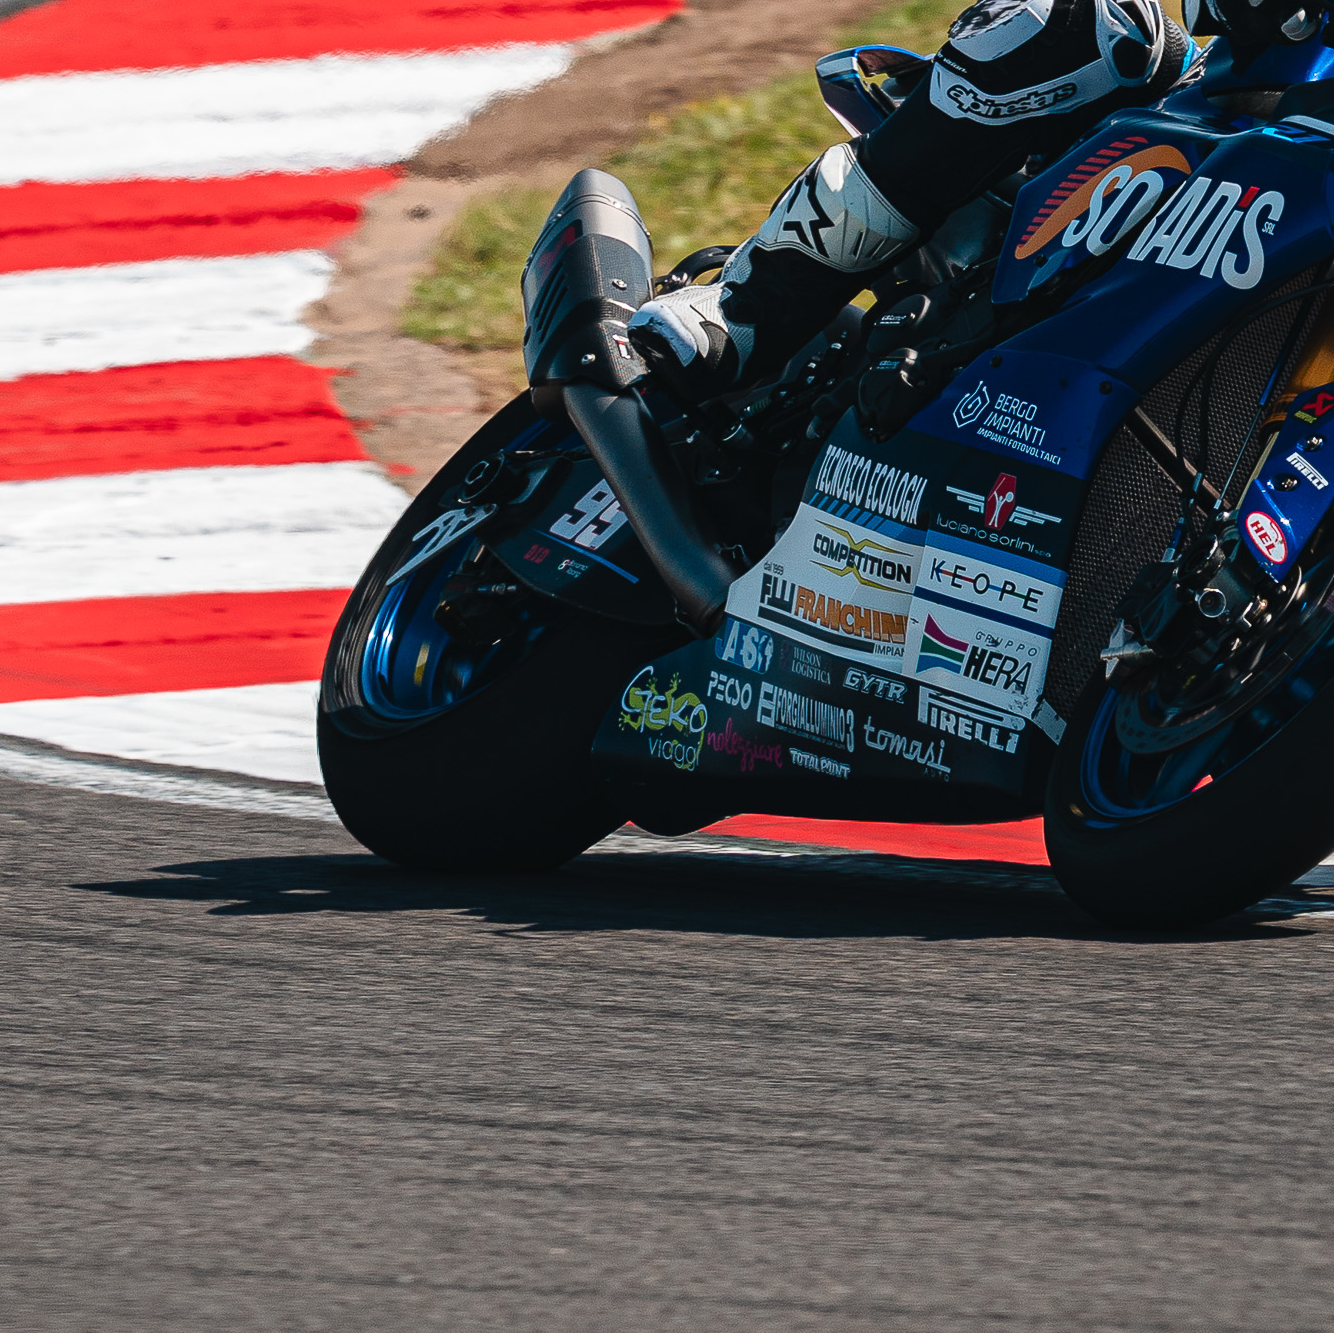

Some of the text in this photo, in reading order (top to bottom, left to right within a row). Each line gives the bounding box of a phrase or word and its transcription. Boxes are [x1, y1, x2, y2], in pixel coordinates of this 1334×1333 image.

[947, 82, 1077, 118] alpinestars
[994, 393, 1038, 421] BERGO
[976, 427, 1062, 466] IMPIANTI FOTOVOLTAICI
[983, 411, 1046, 446] IMPIANTI
[815, 444, 929, 525] TECNOECO ECOLOGIA
[1285, 452, 1329, 490] PIRELLI
[936, 514, 988, 539] luciano
[988, 532, 1036, 553] sorlini
[1249, 519, 1278, 557] HEL
[813, 533, 912, 584] COMPETITION
[930, 557, 1044, 613] KEOPE
[794, 585, 908, 644] FRANCHIN
[793, 646, 822, 667] WILSON
[975, 630, 1038, 658] GRUPPO
[791, 659, 832, 685] LOGISTICA
[843, 667, 908, 704] GYTR
[963, 645, 1032, 695] HERA
[917, 685, 1026, 754] PIRELLI
[648, 732, 701, 771] viaggi
[863, 716, 952, 773] tomasi
